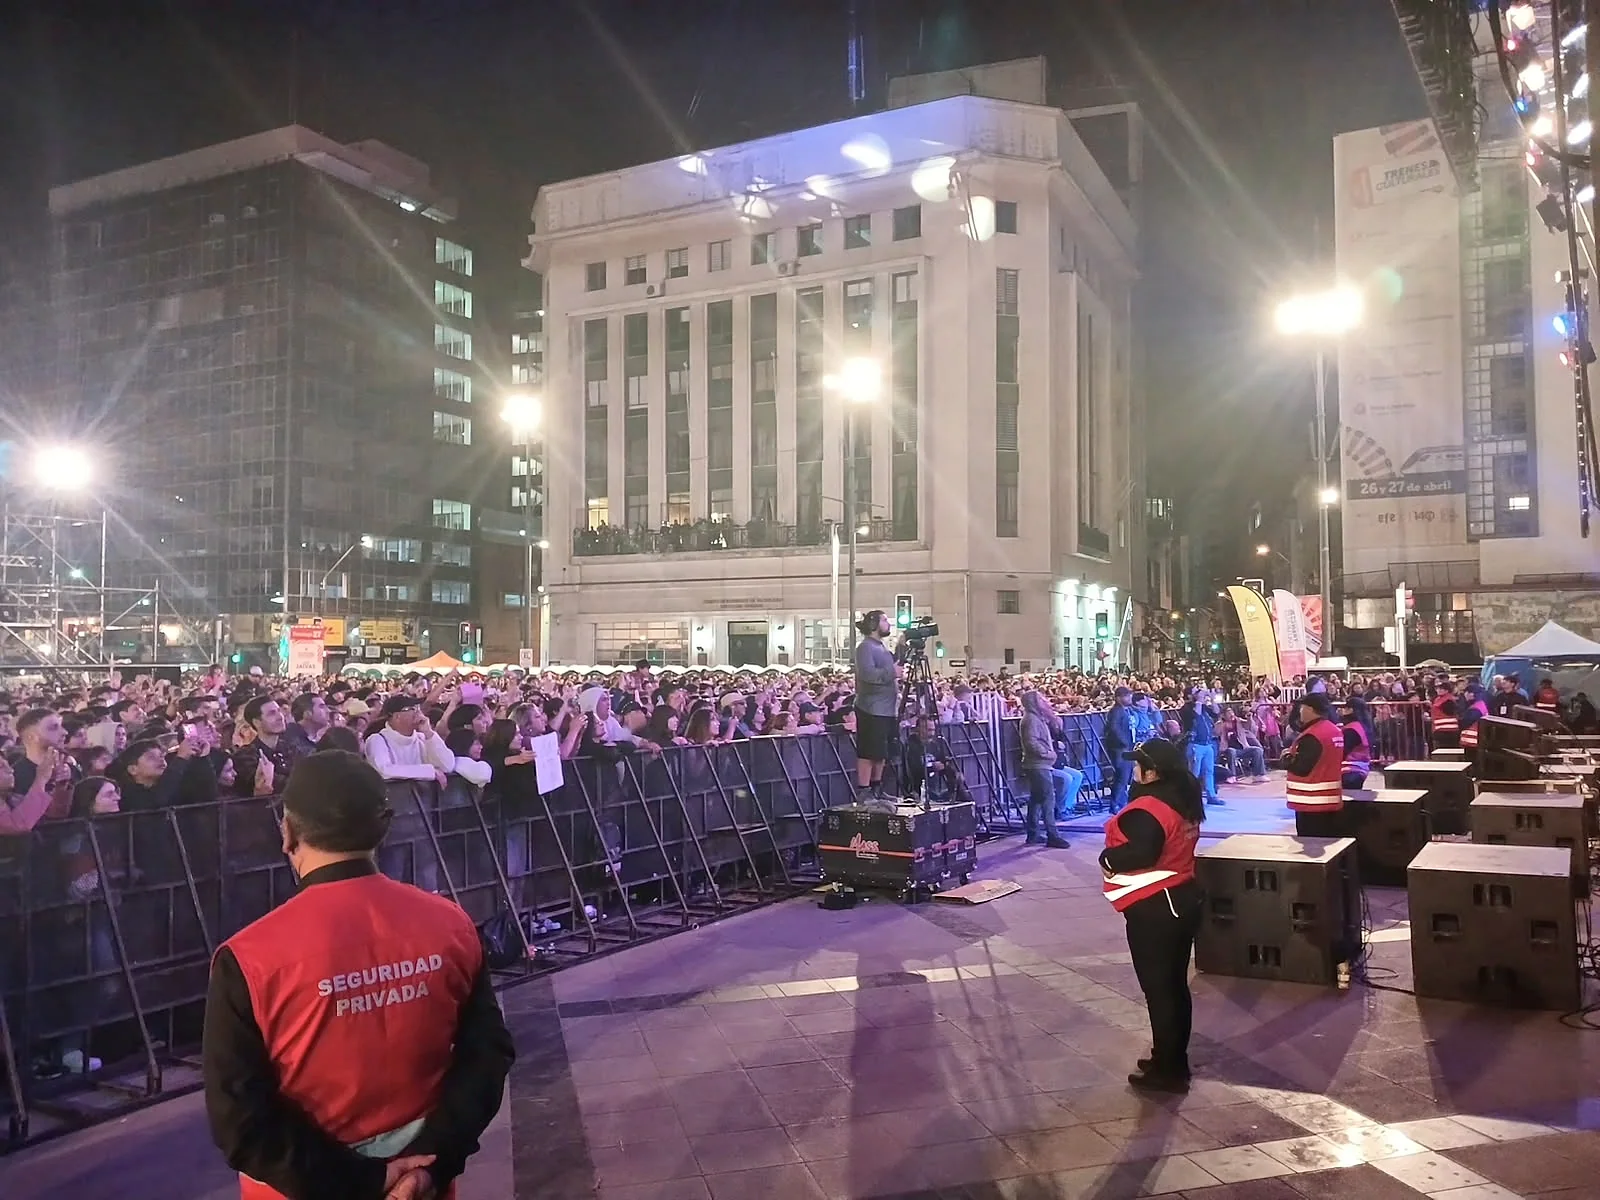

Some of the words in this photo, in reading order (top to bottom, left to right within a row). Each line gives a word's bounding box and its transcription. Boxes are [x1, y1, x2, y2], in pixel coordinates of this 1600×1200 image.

[1360, 482, 1378, 495] 26
[1388, 481, 1405, 493] 27
[1406, 483, 1421, 492] de
[1423, 480, 1452, 491] abril
[317, 953, 443, 997] SEGURIDAD
[336, 980, 430, 1017] PRIVADA
